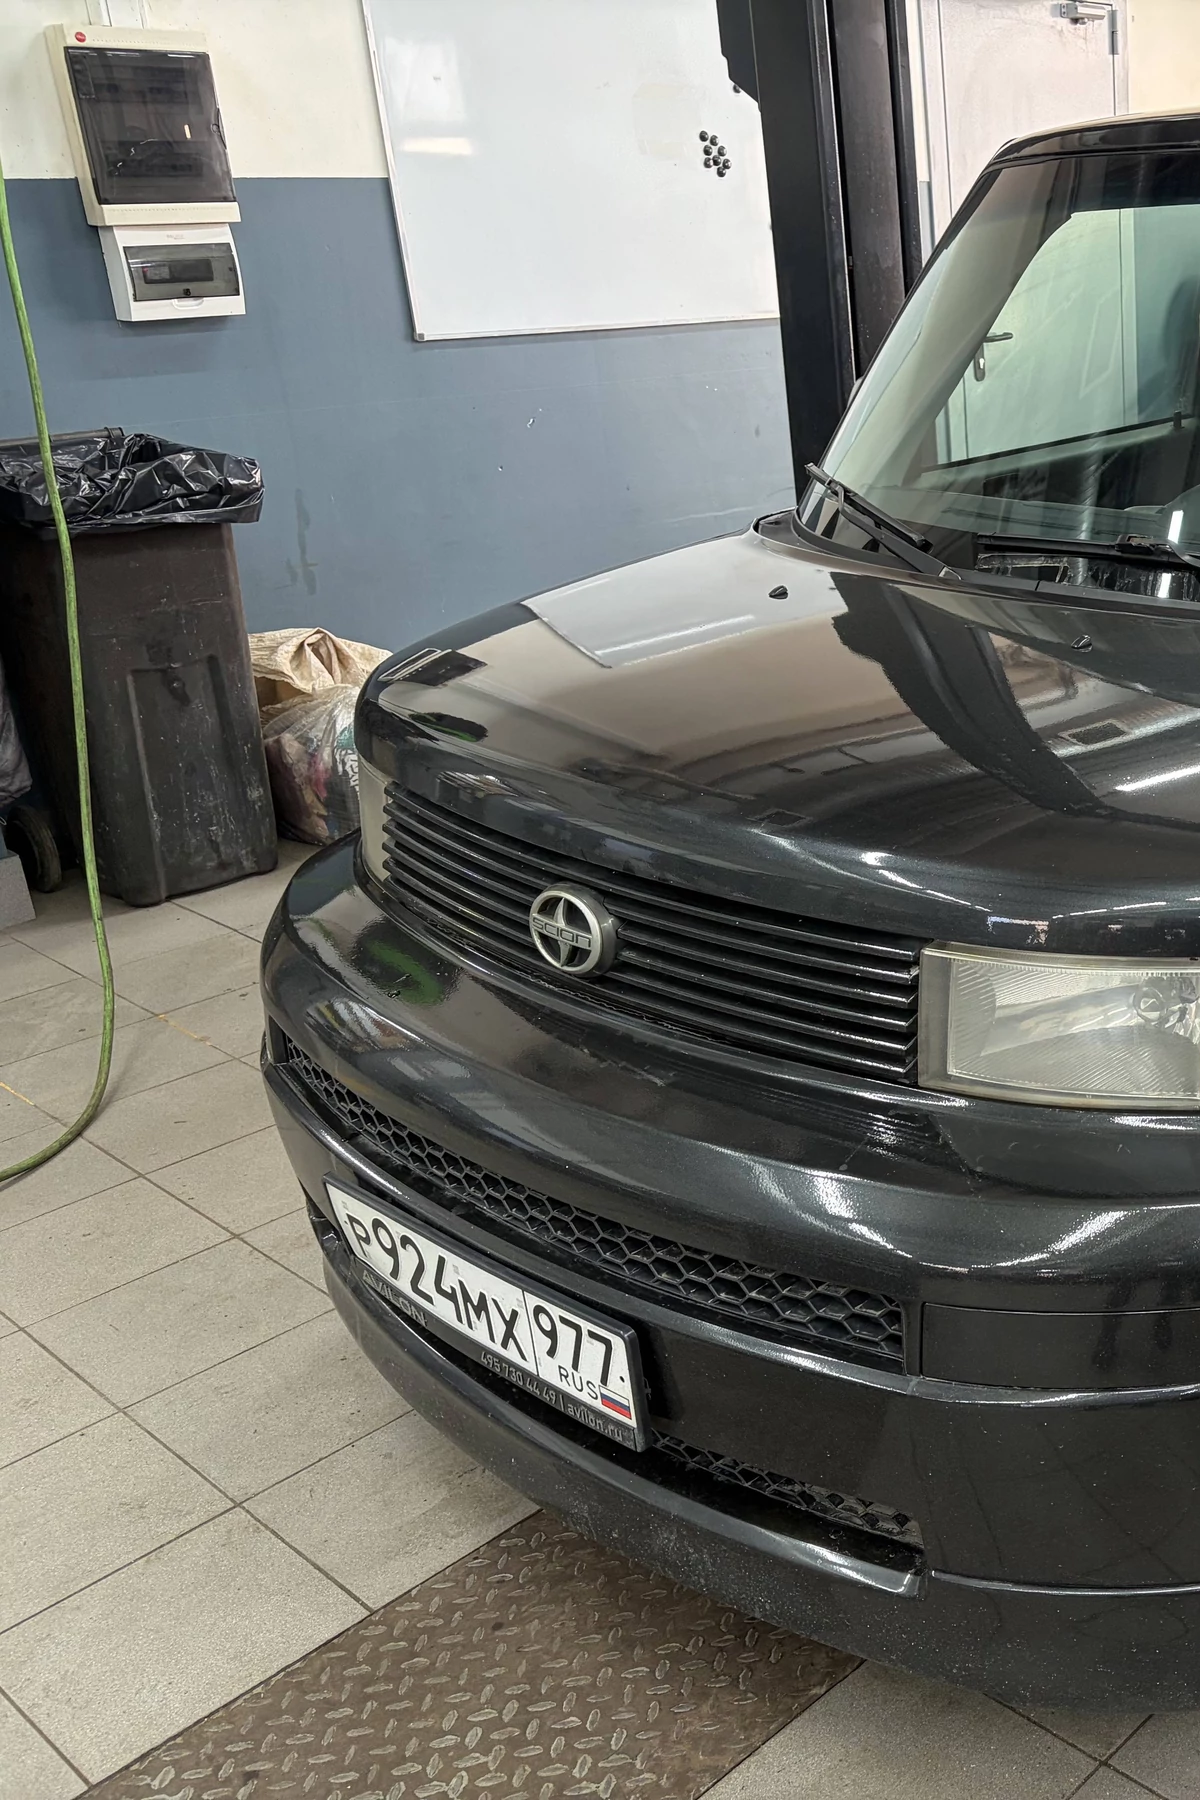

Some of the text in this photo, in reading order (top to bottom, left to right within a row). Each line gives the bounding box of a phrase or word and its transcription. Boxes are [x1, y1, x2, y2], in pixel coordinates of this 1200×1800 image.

[362, 1269, 428, 1328] AVILON
[533, 1303, 613, 1387] 977
[480, 1351, 623, 1442] 495 730 44 49 avilon.ru
[558, 1364, 599, 1401] RUS
